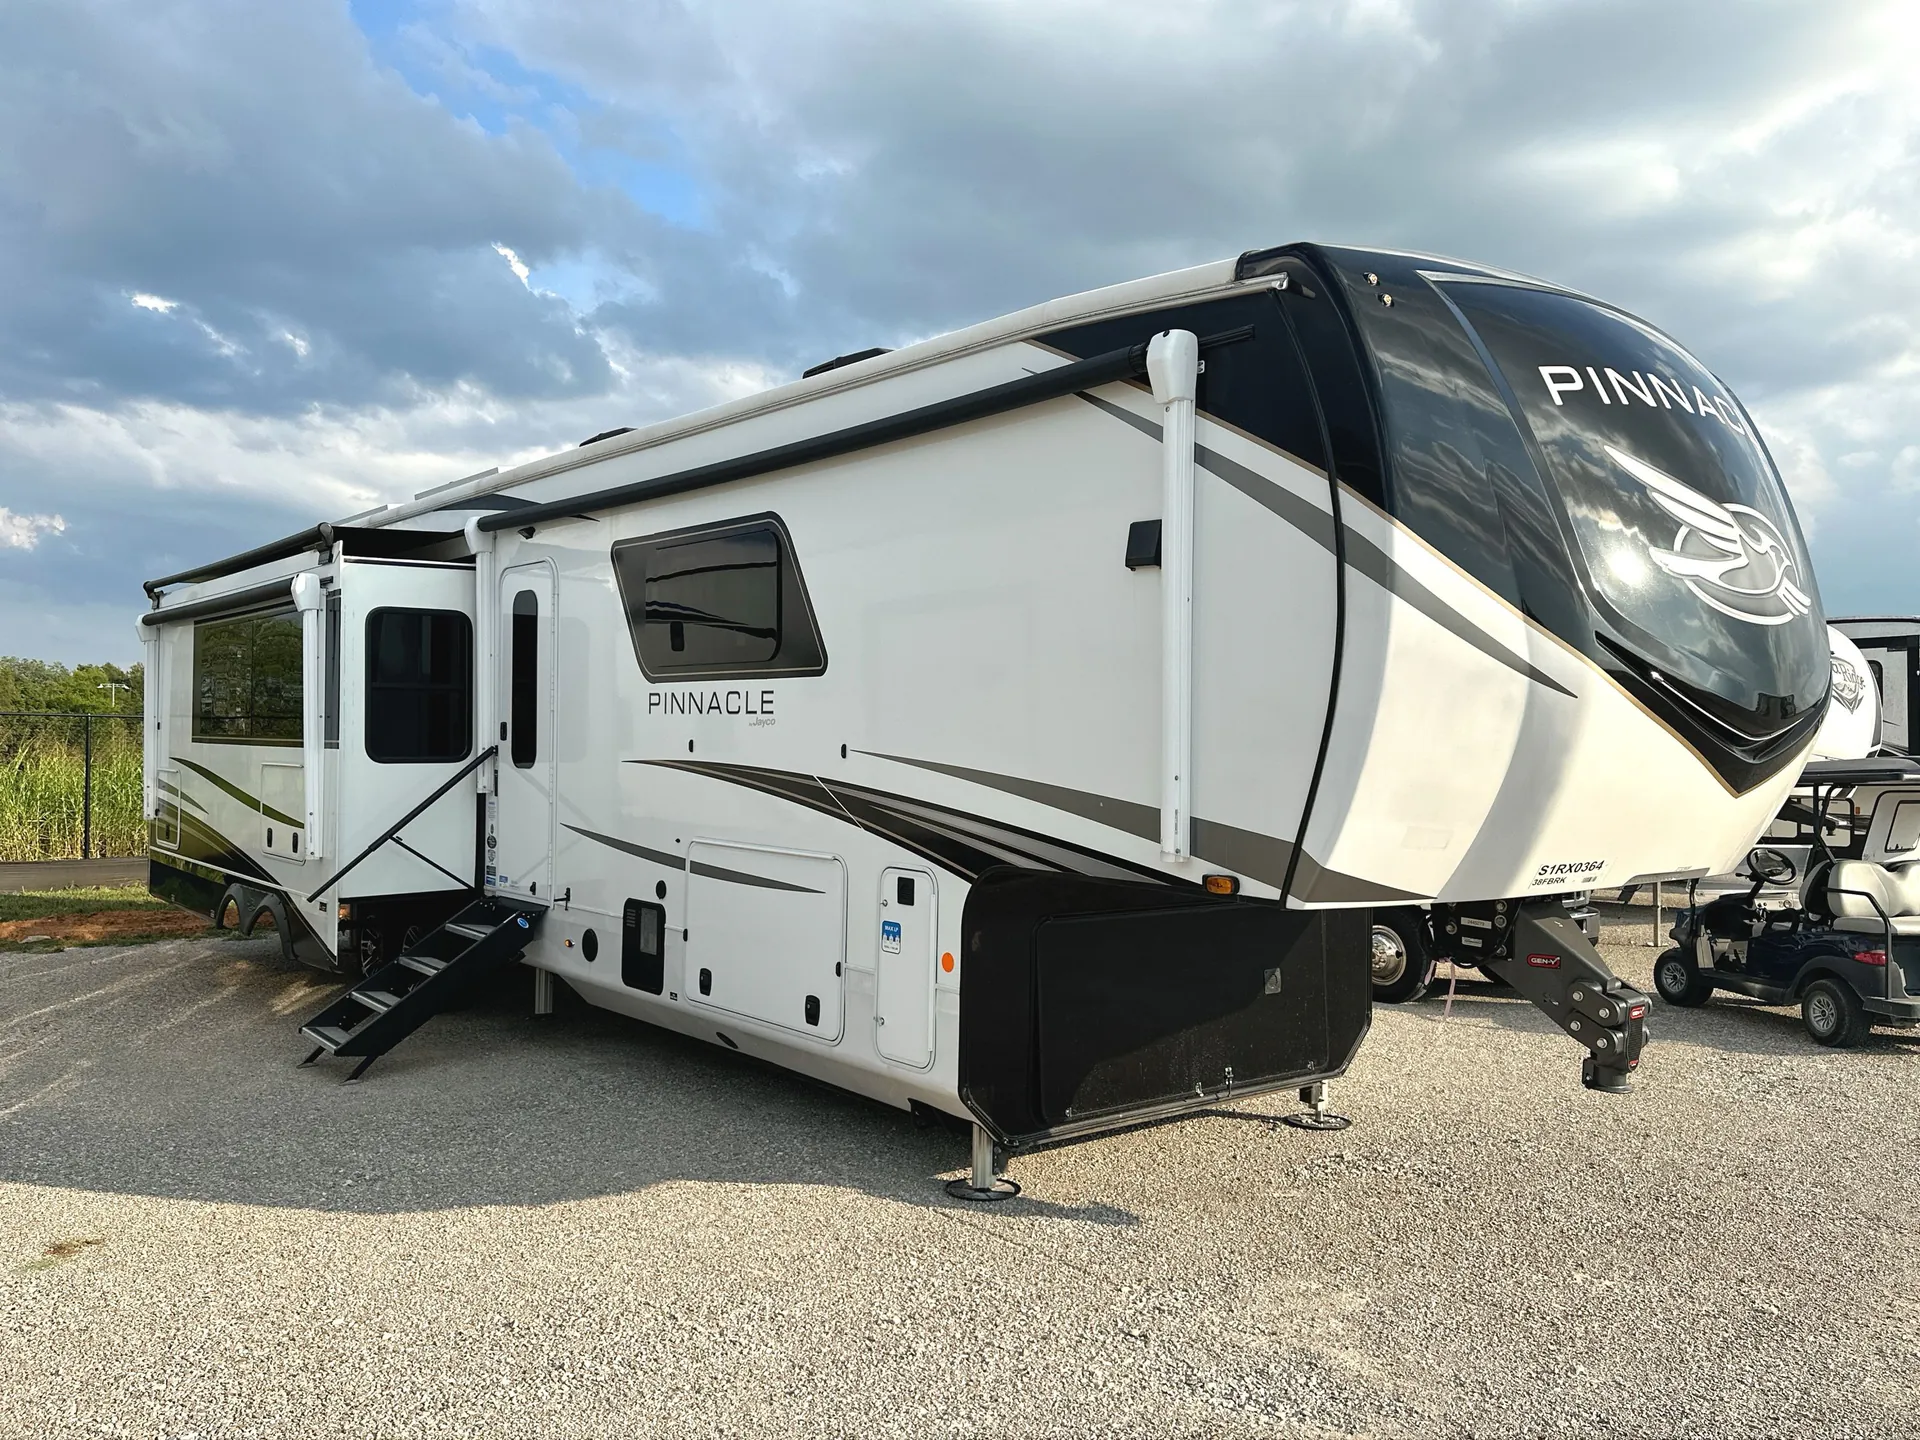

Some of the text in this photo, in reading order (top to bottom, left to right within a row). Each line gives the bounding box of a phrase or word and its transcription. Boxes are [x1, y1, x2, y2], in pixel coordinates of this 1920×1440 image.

[1538, 365, 1748, 437] PINNAC
[648, 690, 775, 715] PINNACLE
[752, 717, 776, 728] Jayco
[1538, 859, 1605, 876] S1RX0364
[1532, 876, 1567, 886] 38FBRK
[1531, 956, 1561, 965] GEN-Y
